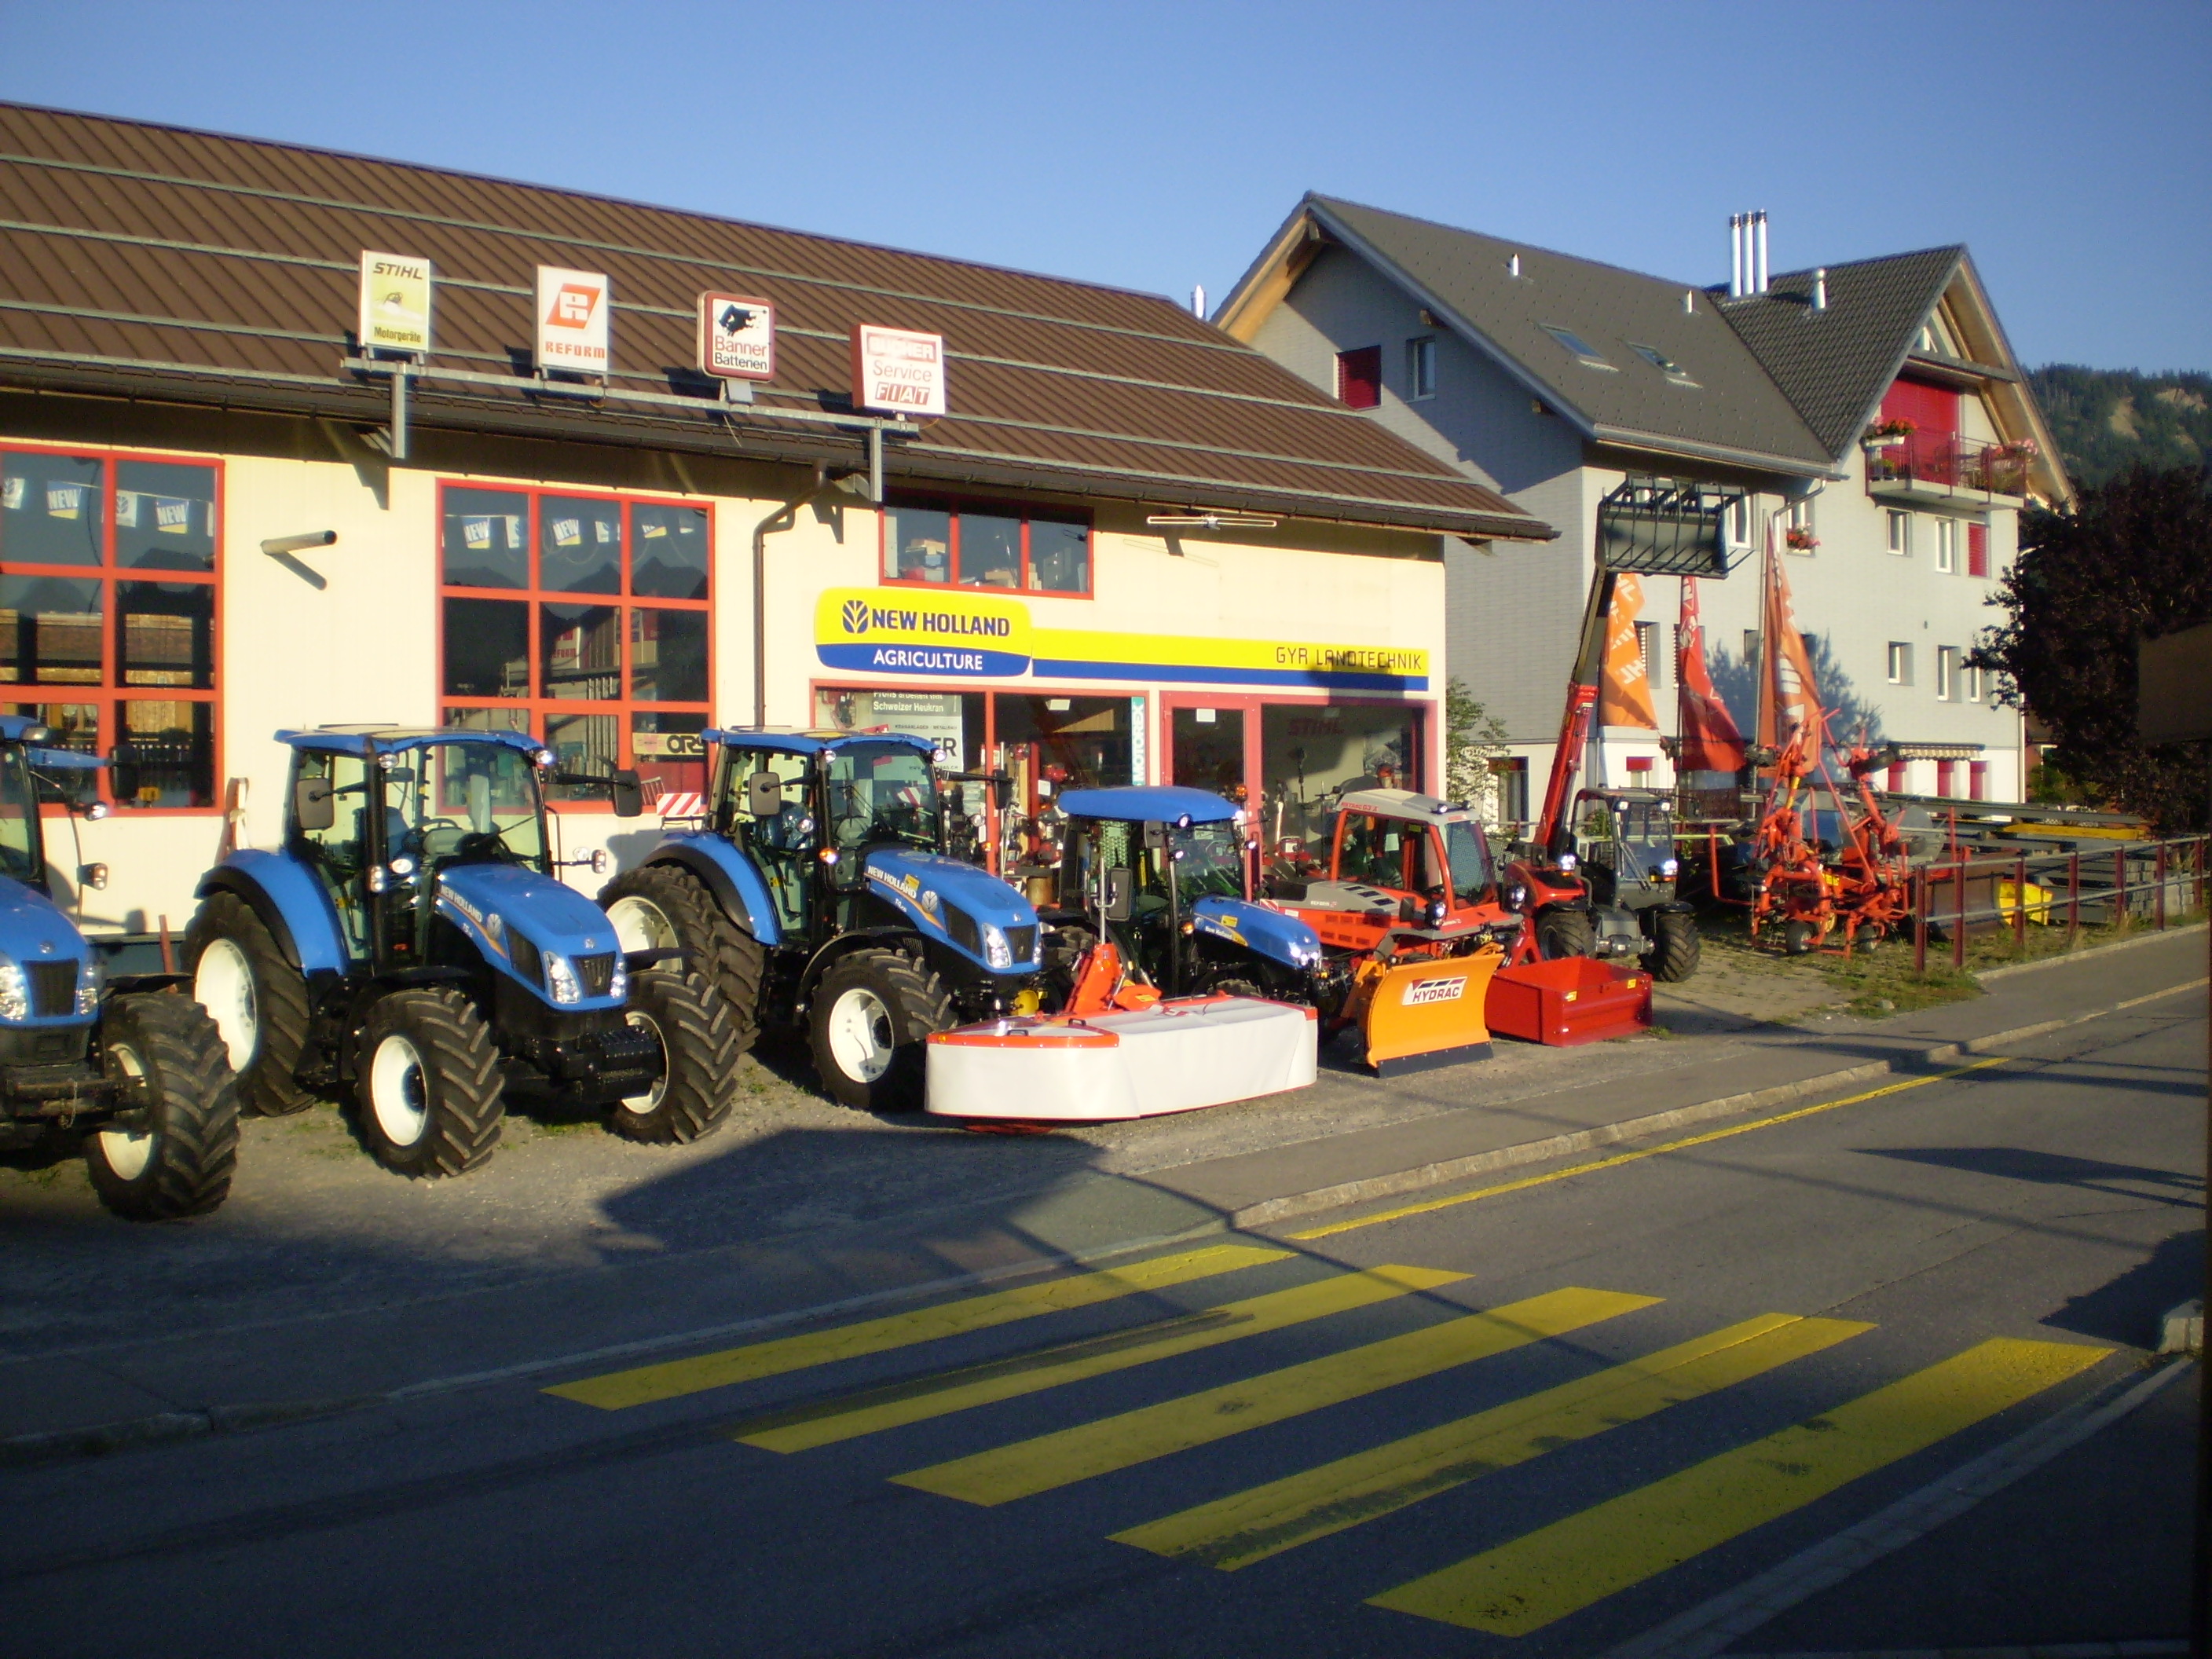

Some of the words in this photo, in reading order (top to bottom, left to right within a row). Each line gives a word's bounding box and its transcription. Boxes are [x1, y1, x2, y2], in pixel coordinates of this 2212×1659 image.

[373, 262, 423, 280] STIHL
[374, 326, 422, 343] Motorgeräte
[545, 341, 606, 359] REFORM
[715, 335, 767, 357] Banner
[873, 360, 932, 382] Service
[875, 382, 931, 405] FIAT
[47, 489, 79, 509] NEW
[156, 504, 187, 525] NEW
[872, 608, 917, 631] NEW
[922, 613, 1011, 636] HOLLAND
[873, 649, 983, 671] AGRICULTURE
[1276, 646, 1309, 665] GYR
[1317, 649, 1423, 670] LANDTECHNIK
[873, 701, 913, 711] Schweizer
[914, 702, 944, 712] Heukran
[867, 865, 884, 879] NEW
[884, 872, 917, 899] HOLLAND
[441, 884, 454, 900] NEW
[454, 892, 482, 922] HOLLAND
[1412, 987, 1460, 1002] HYDRAC
